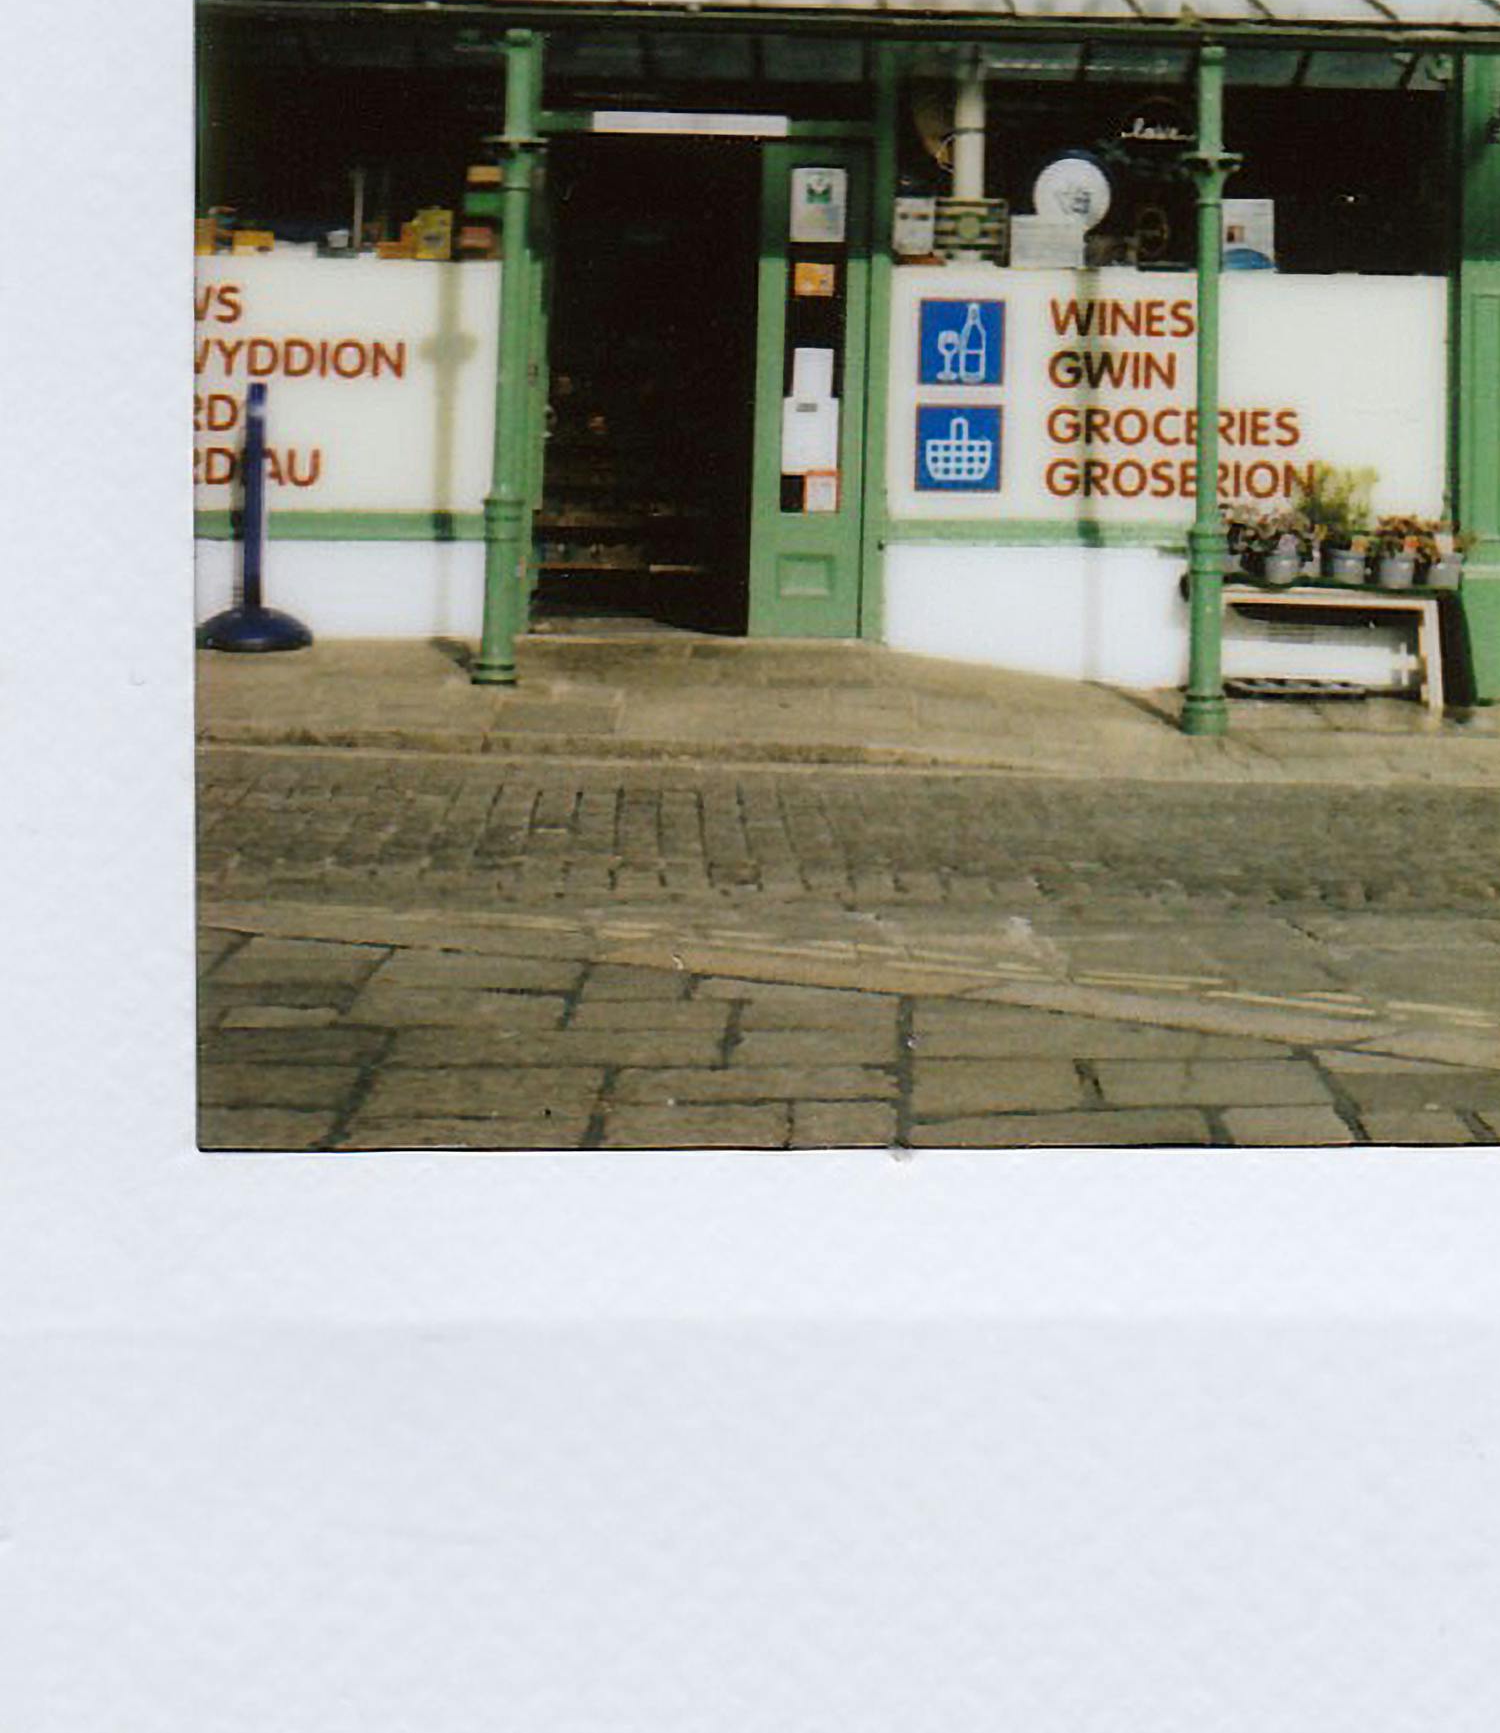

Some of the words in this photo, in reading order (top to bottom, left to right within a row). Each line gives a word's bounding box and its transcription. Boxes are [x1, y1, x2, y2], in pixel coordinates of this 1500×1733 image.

[1051, 299, 1195, 338] WINES
[1048, 350, 1177, 389] GWIN
[1047, 408, 1300, 447] GROCERIES
